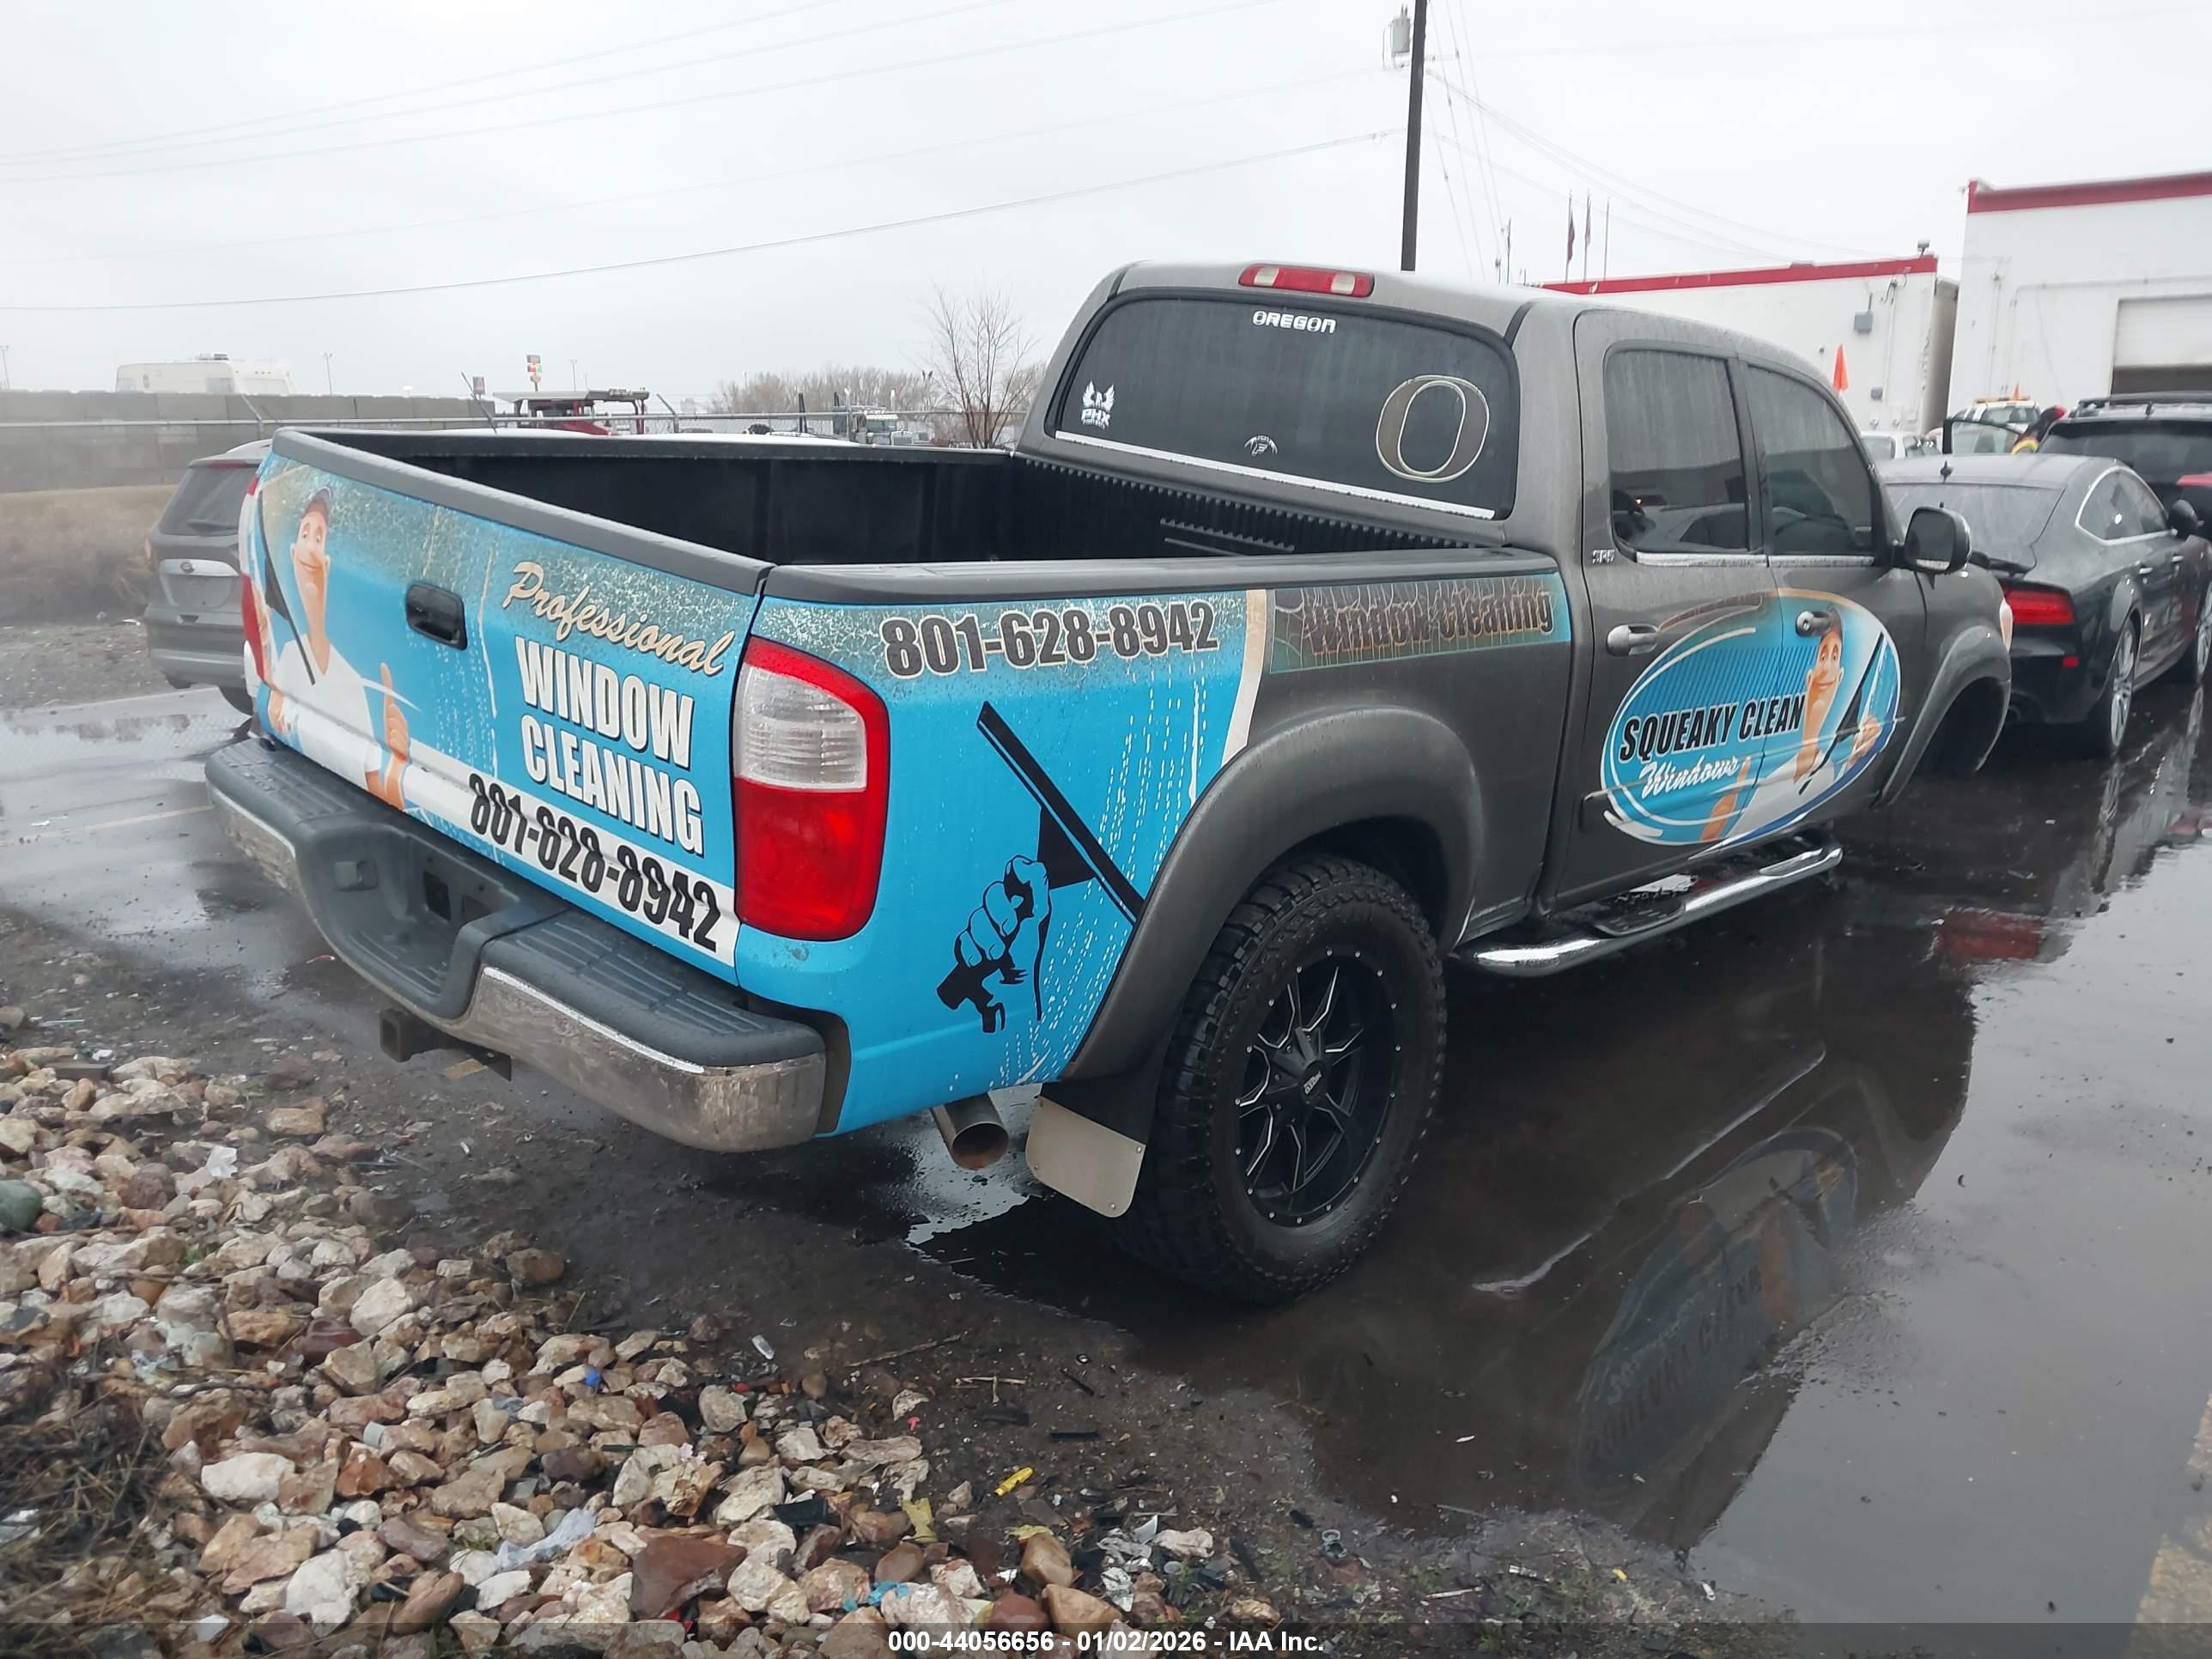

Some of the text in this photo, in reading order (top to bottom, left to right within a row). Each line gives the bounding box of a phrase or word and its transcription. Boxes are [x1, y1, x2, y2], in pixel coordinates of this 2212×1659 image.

[1252, 310, 1337, 334] OREGON
[503, 561, 734, 676] Professional
[881, 602, 1219, 679] 801-628-8942
[515, 636, 694, 769] WINDOW
[1619, 692, 1805, 763] SQUEAKY CLEAN
[520, 714, 705, 857] CLEANING
[1639, 755, 1738, 799] Windows
[469, 774, 721, 951] 801-628-8942
